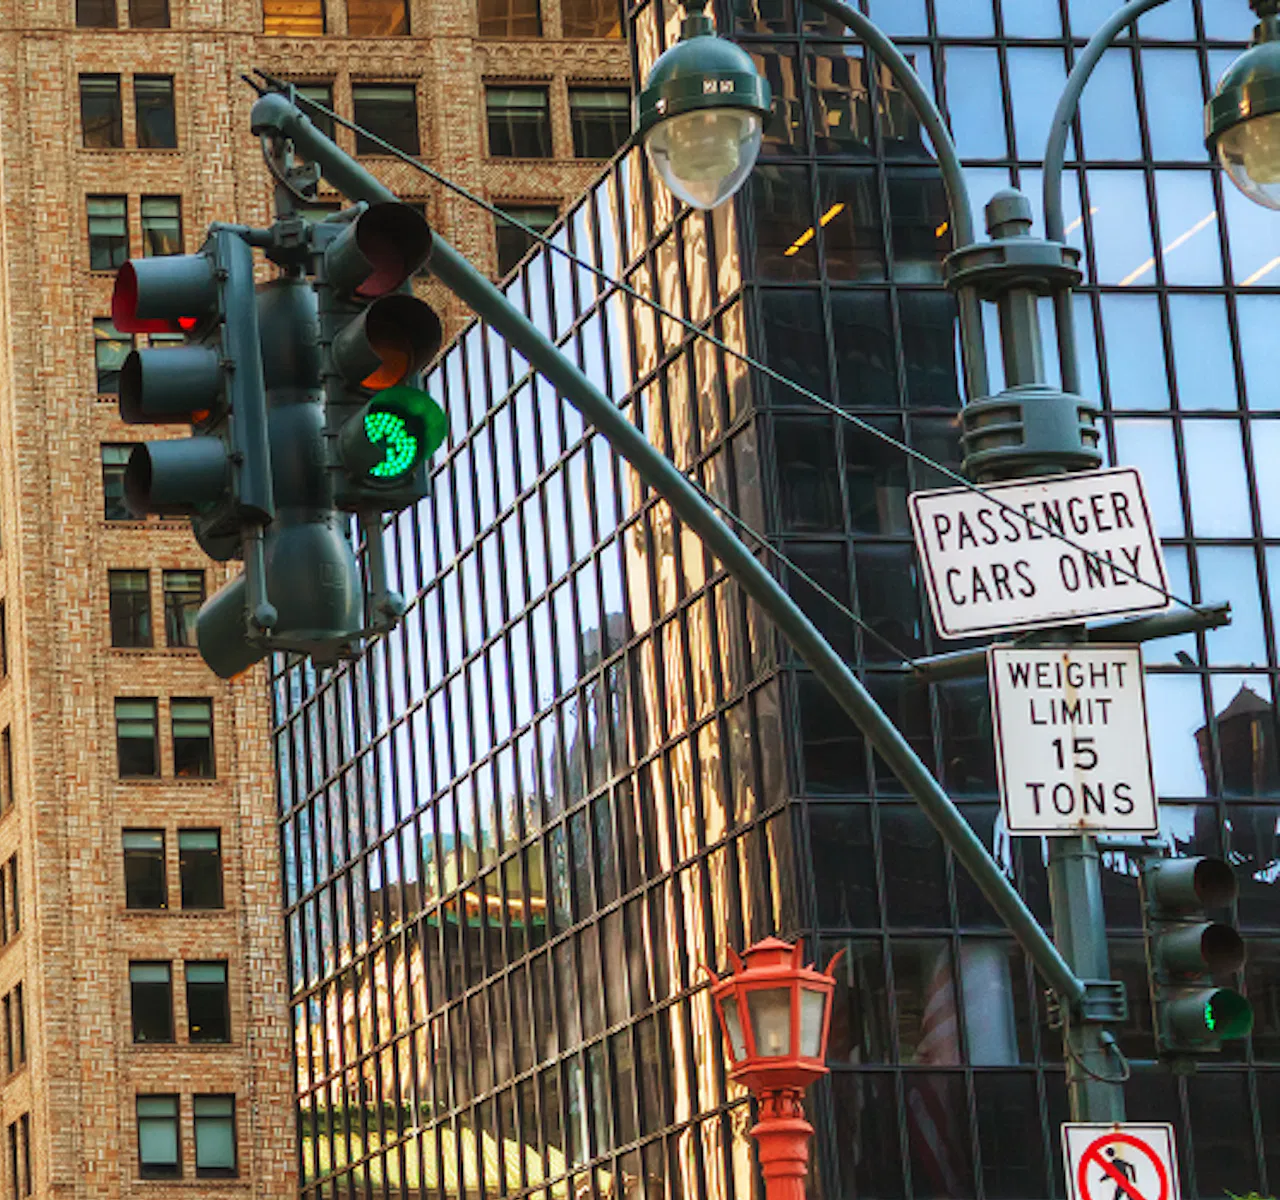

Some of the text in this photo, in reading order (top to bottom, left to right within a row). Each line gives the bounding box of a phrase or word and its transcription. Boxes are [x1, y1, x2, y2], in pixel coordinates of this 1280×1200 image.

[933, 491, 1135, 552] PASSENGER
[946, 544, 1142, 606] CARS ONLY
[1007, 661, 1128, 689] WEIGHT
[1030, 698, 1113, 726] LIMIT
[1052, 737, 1099, 771] 15
[1025, 782, 1135, 816] TONS
